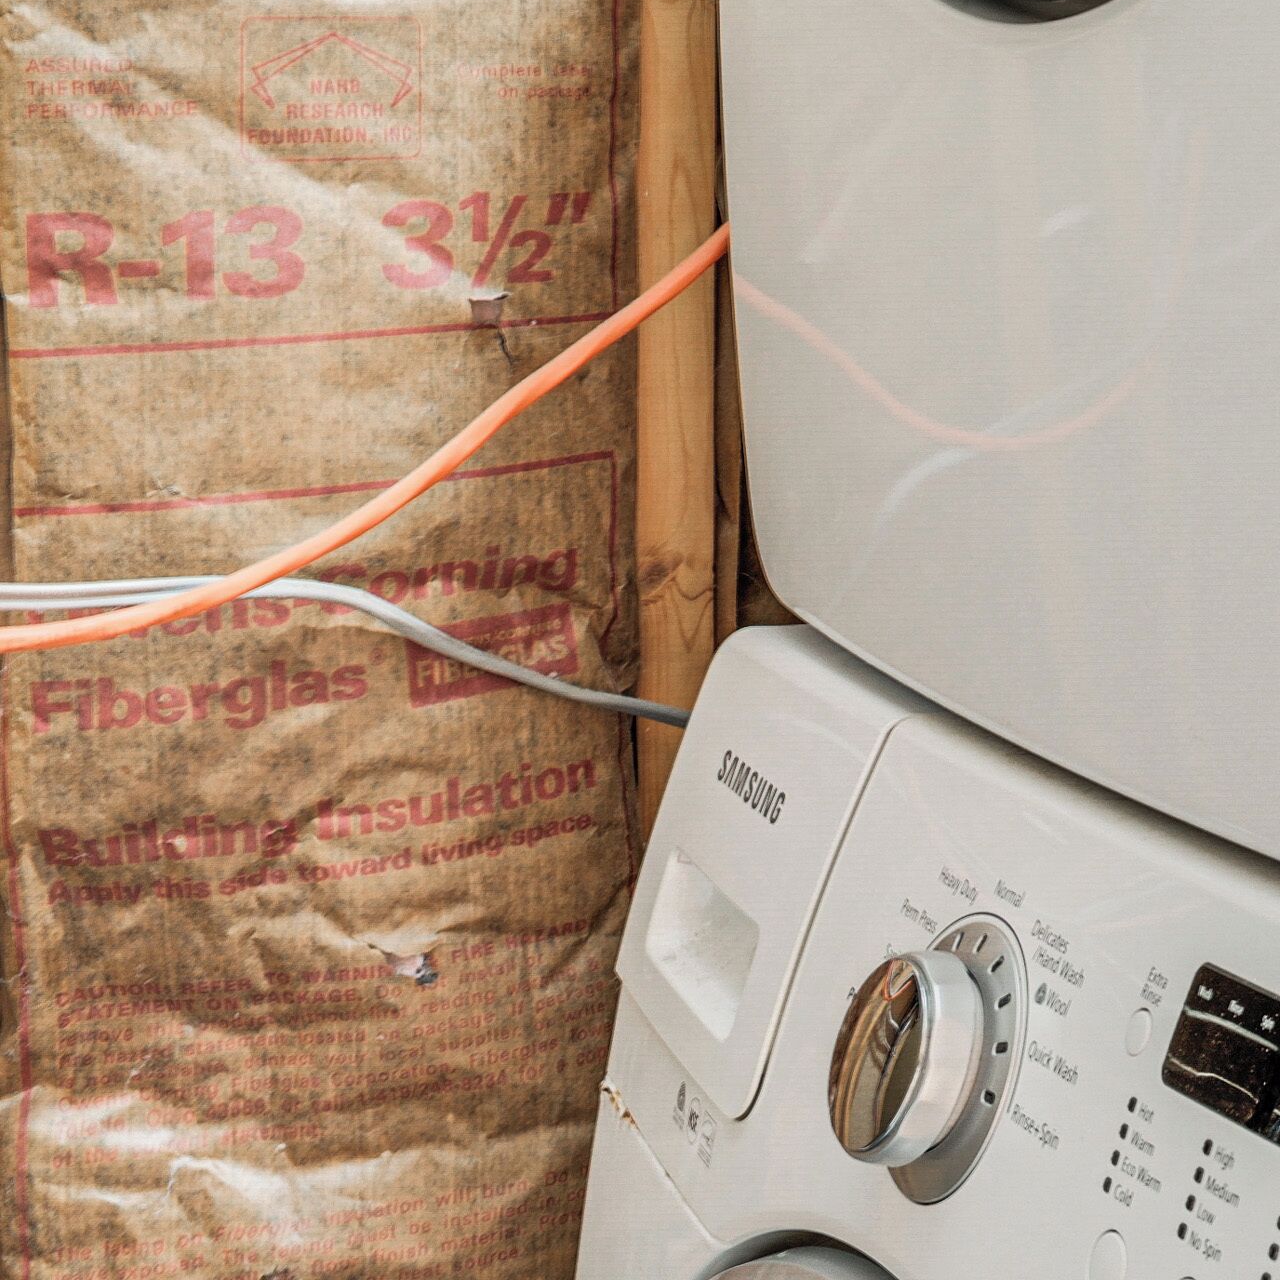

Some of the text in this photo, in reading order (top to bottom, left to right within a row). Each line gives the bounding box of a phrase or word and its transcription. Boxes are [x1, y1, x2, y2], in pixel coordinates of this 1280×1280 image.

[309, 78, 362, 95] NAHB
[26, 100, 199, 119] PERFORMANCE
[285, 102, 385, 119] RESEARCH
[24, 203, 305, 310] R-13
[717, 749, 786, 824] SAMSUNG
[38, 759, 597, 870] Building Insulation
[47, 876, 143, 909] Apply
[153, 863, 212, 900] this
[219, 853, 288, 898] side
[299, 848, 412, 885] toward
[421, 831, 503, 869] living
[938, 865, 979, 906] Heavy Duty
[994, 880, 1026, 908] Normal
[900, 898, 938, 934] Perm Press
[1031, 920, 1070, 954] Delicates
[1061, 964, 1086, 989] Wash
[1148, 967, 1169, 990] Extra
[1046, 989, 1072, 1017] Wool
[1140, 983, 1163, 1007] Rinse
[57, 998, 195, 1029] STATEMENT
[206, 997, 240, 1012] ON
[1028, 1040, 1080, 1085] Quick Wash
[1138, 1102, 1155, 1124] Hot
[1130, 1130, 1156, 1156] Warm
[1213, 1146, 1236, 1171] High
[1120, 1156, 1163, 1193] Eco Warm
[1113, 1184, 1134, 1208] Cold
[1205, 1175, 1241, 1208] Medium
[1196, 1204, 1217, 1226] Low
[1189, 1230, 1222, 1262] No Spin
